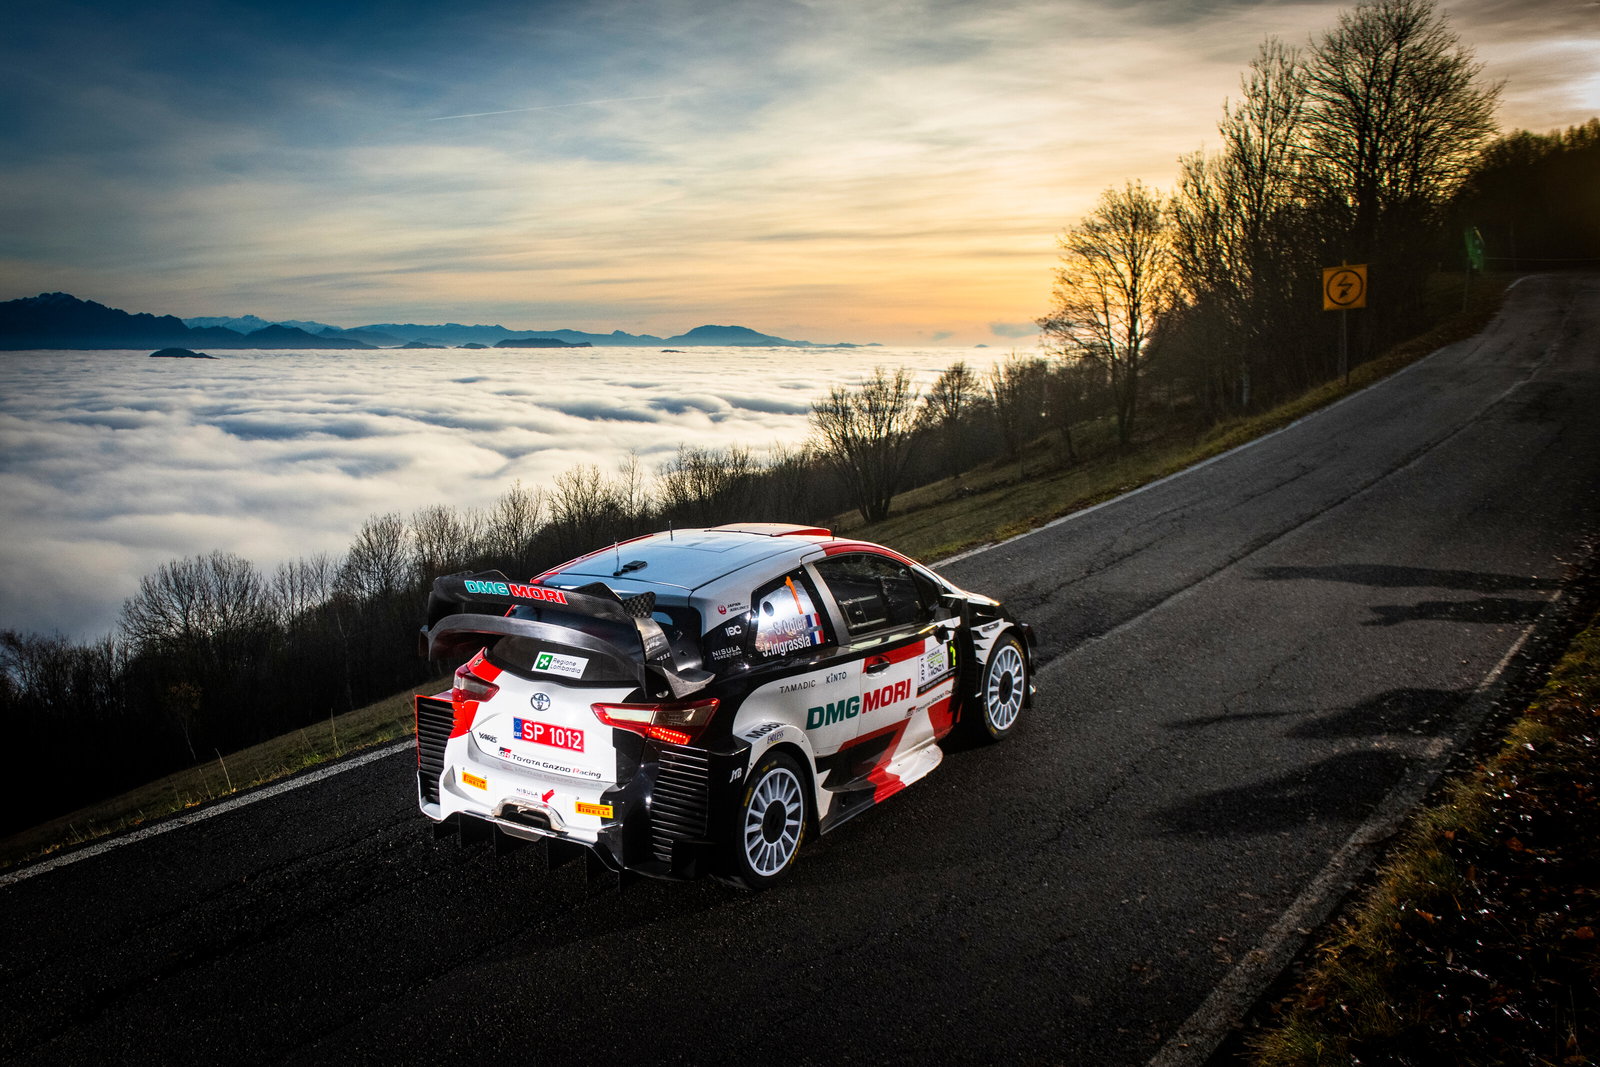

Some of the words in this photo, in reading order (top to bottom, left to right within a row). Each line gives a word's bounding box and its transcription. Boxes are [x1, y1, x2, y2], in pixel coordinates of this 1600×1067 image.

[464, 580, 510, 596] DMG
[509, 583, 569, 606] MORI
[712, 645, 741, 657] NISULA
[762, 633, 812, 657] J.Ingrassia
[550, 663, 581, 674] Lombardia
[552, 657, 577, 667] Regione
[780, 679, 817, 694] TAMADIC
[806, 695, 861, 731] DMG
[861, 678, 912, 715] MORI
[478, 731, 498, 744] YARIS
[523, 722, 545, 741] SP
[549, 727, 583, 750] 1012
[512, 753, 541, 767] TOYOTA
[542, 761, 571, 773] GAZOO
[572, 767, 602, 779] Racing
[463, 773, 487, 790] PIRELLI
[516, 787, 539, 797] NISULA
[577, 803, 612, 817] PIRELLI
